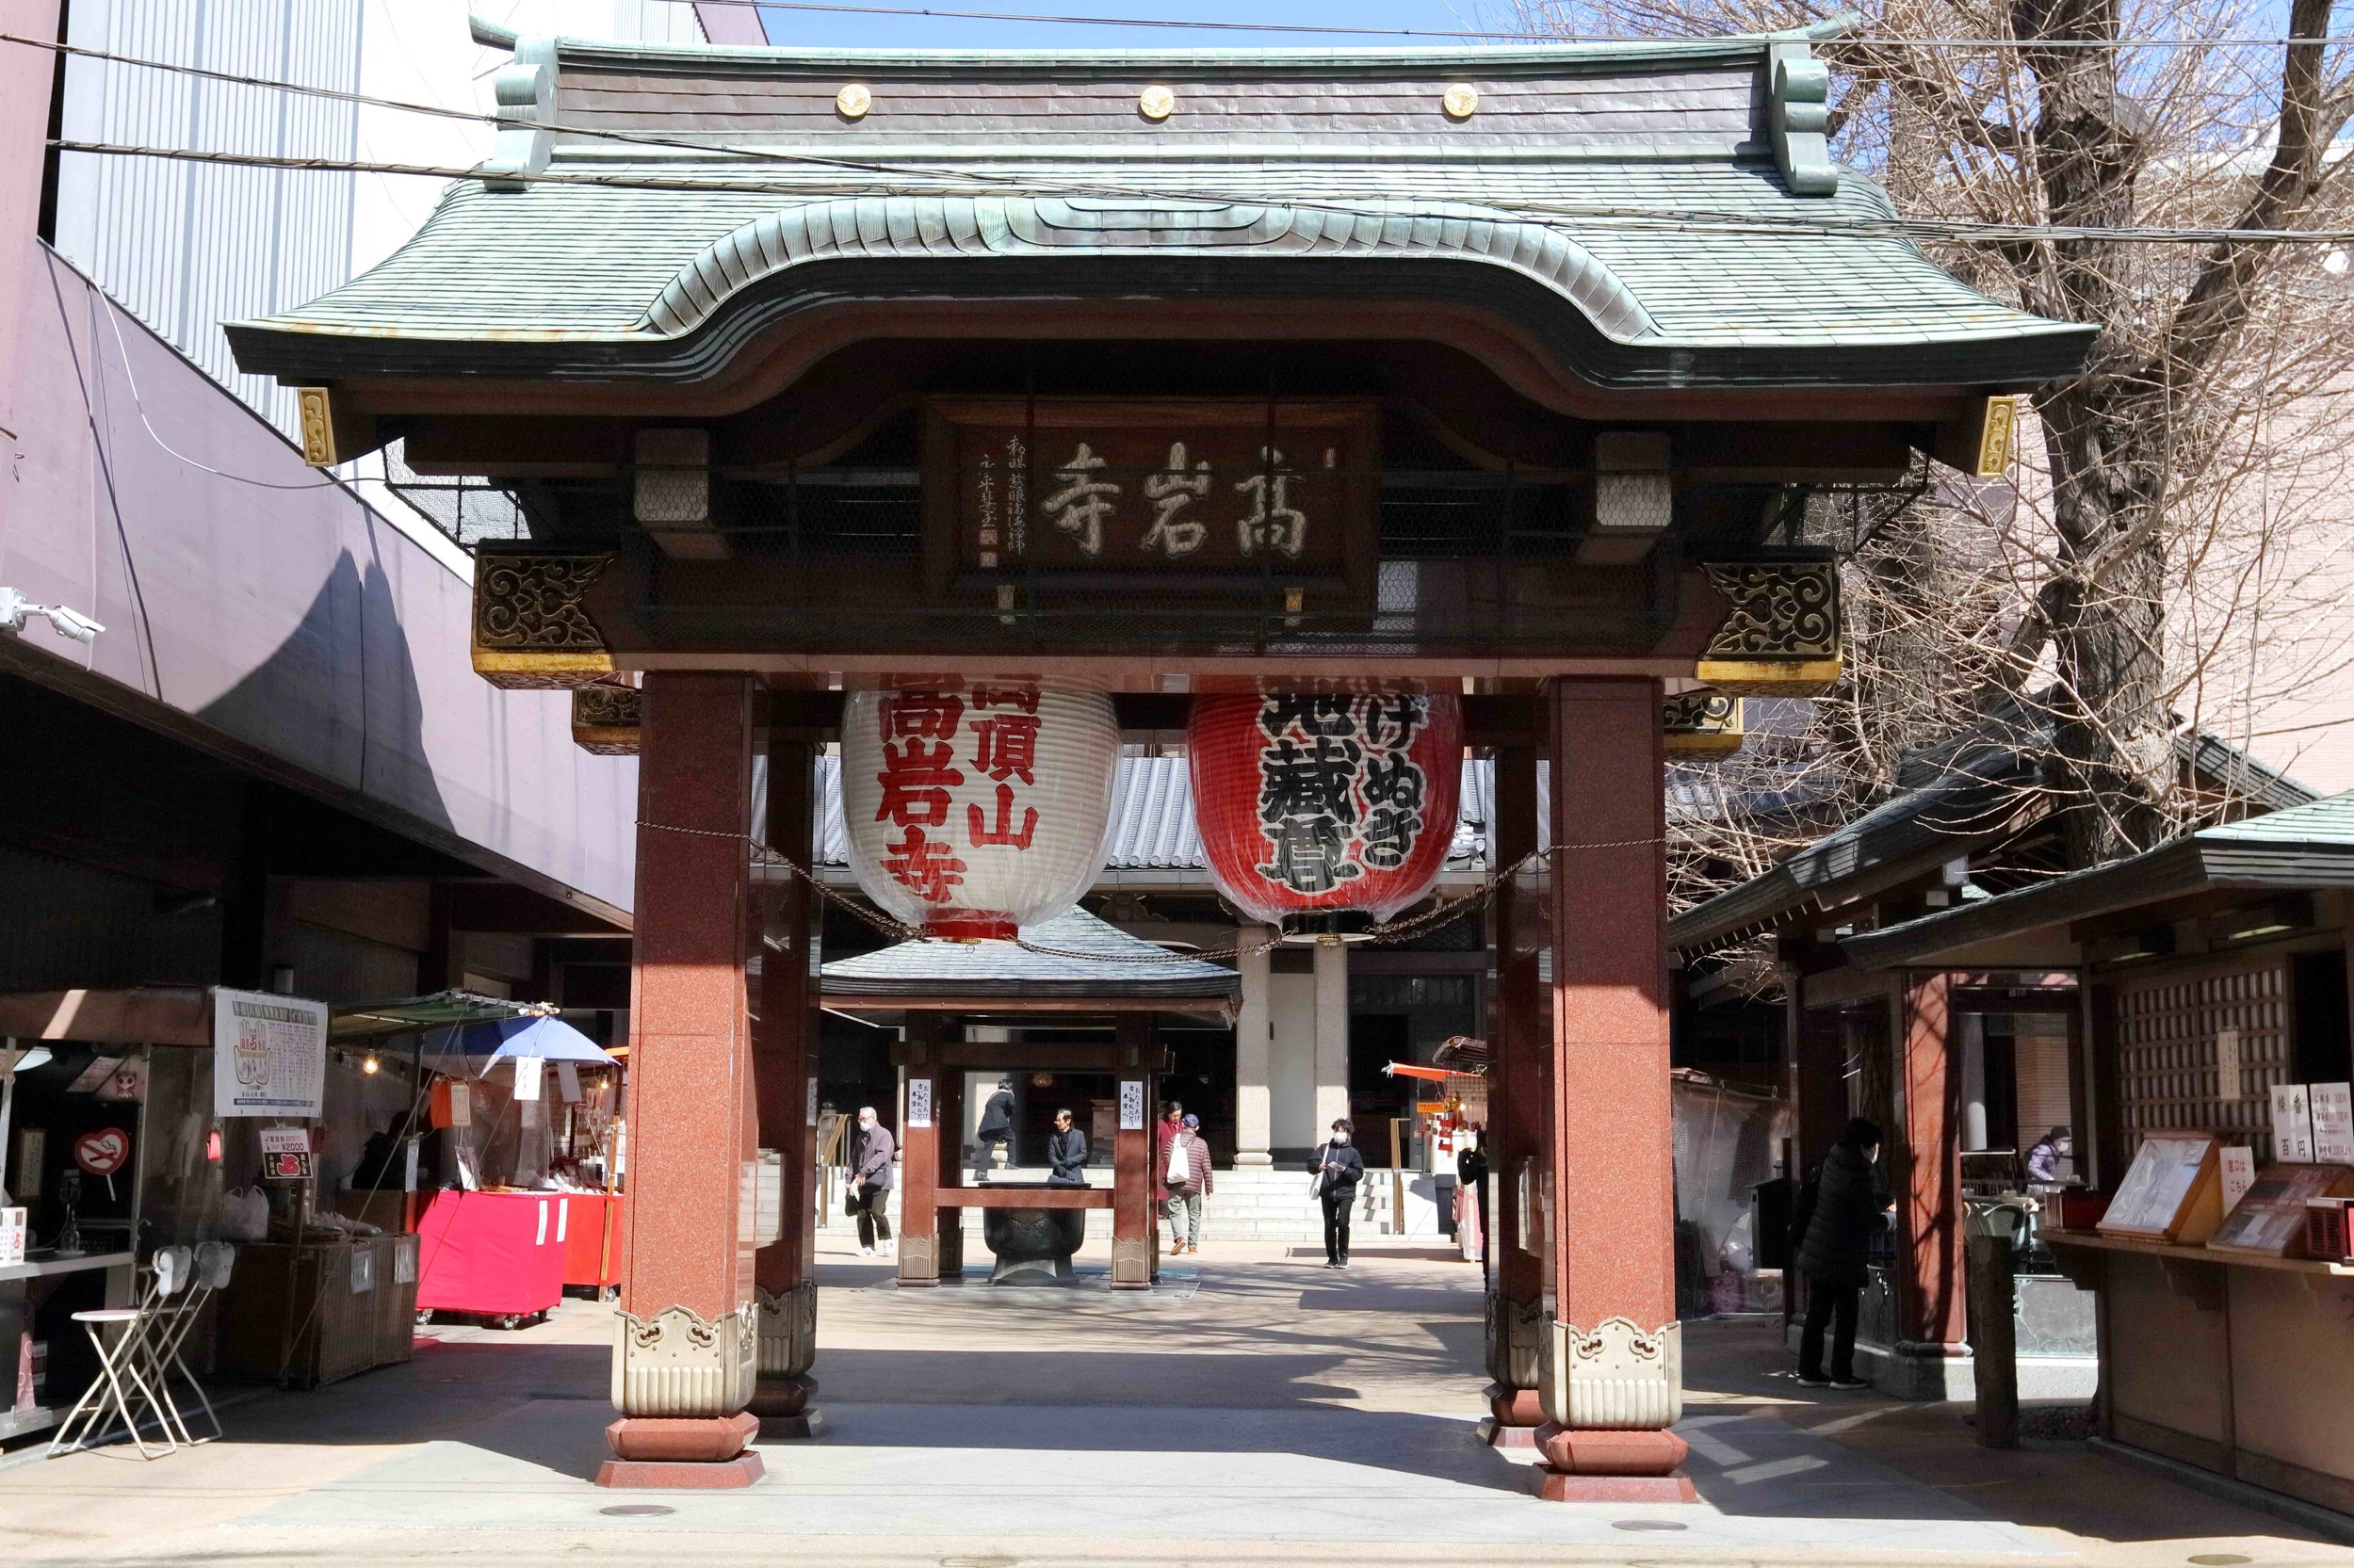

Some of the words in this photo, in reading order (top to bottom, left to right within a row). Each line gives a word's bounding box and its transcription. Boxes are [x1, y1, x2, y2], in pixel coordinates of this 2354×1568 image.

[1042, 442, 1307, 558] 高岩寺
[2281, 1138, 2306, 1158] 百円
